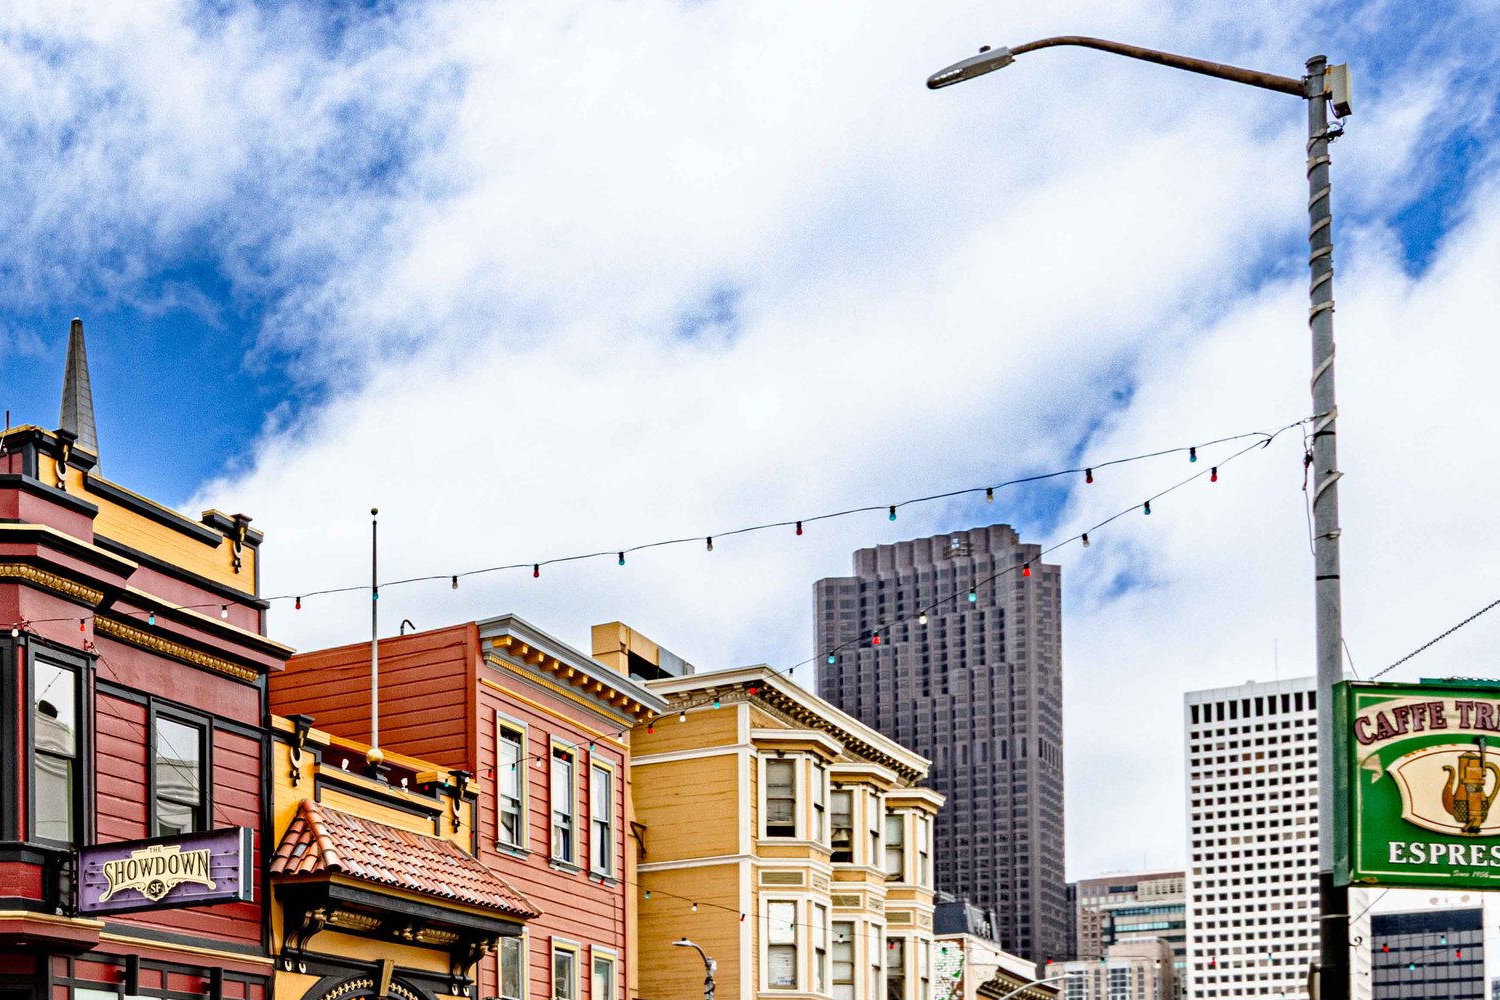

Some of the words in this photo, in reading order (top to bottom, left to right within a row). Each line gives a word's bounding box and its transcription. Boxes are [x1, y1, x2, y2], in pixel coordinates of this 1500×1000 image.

[1354, 701, 1448, 746] CAFFE
[103, 850, 210, 900] SHOWDOWN
[150, 883, 162, 894] SF
